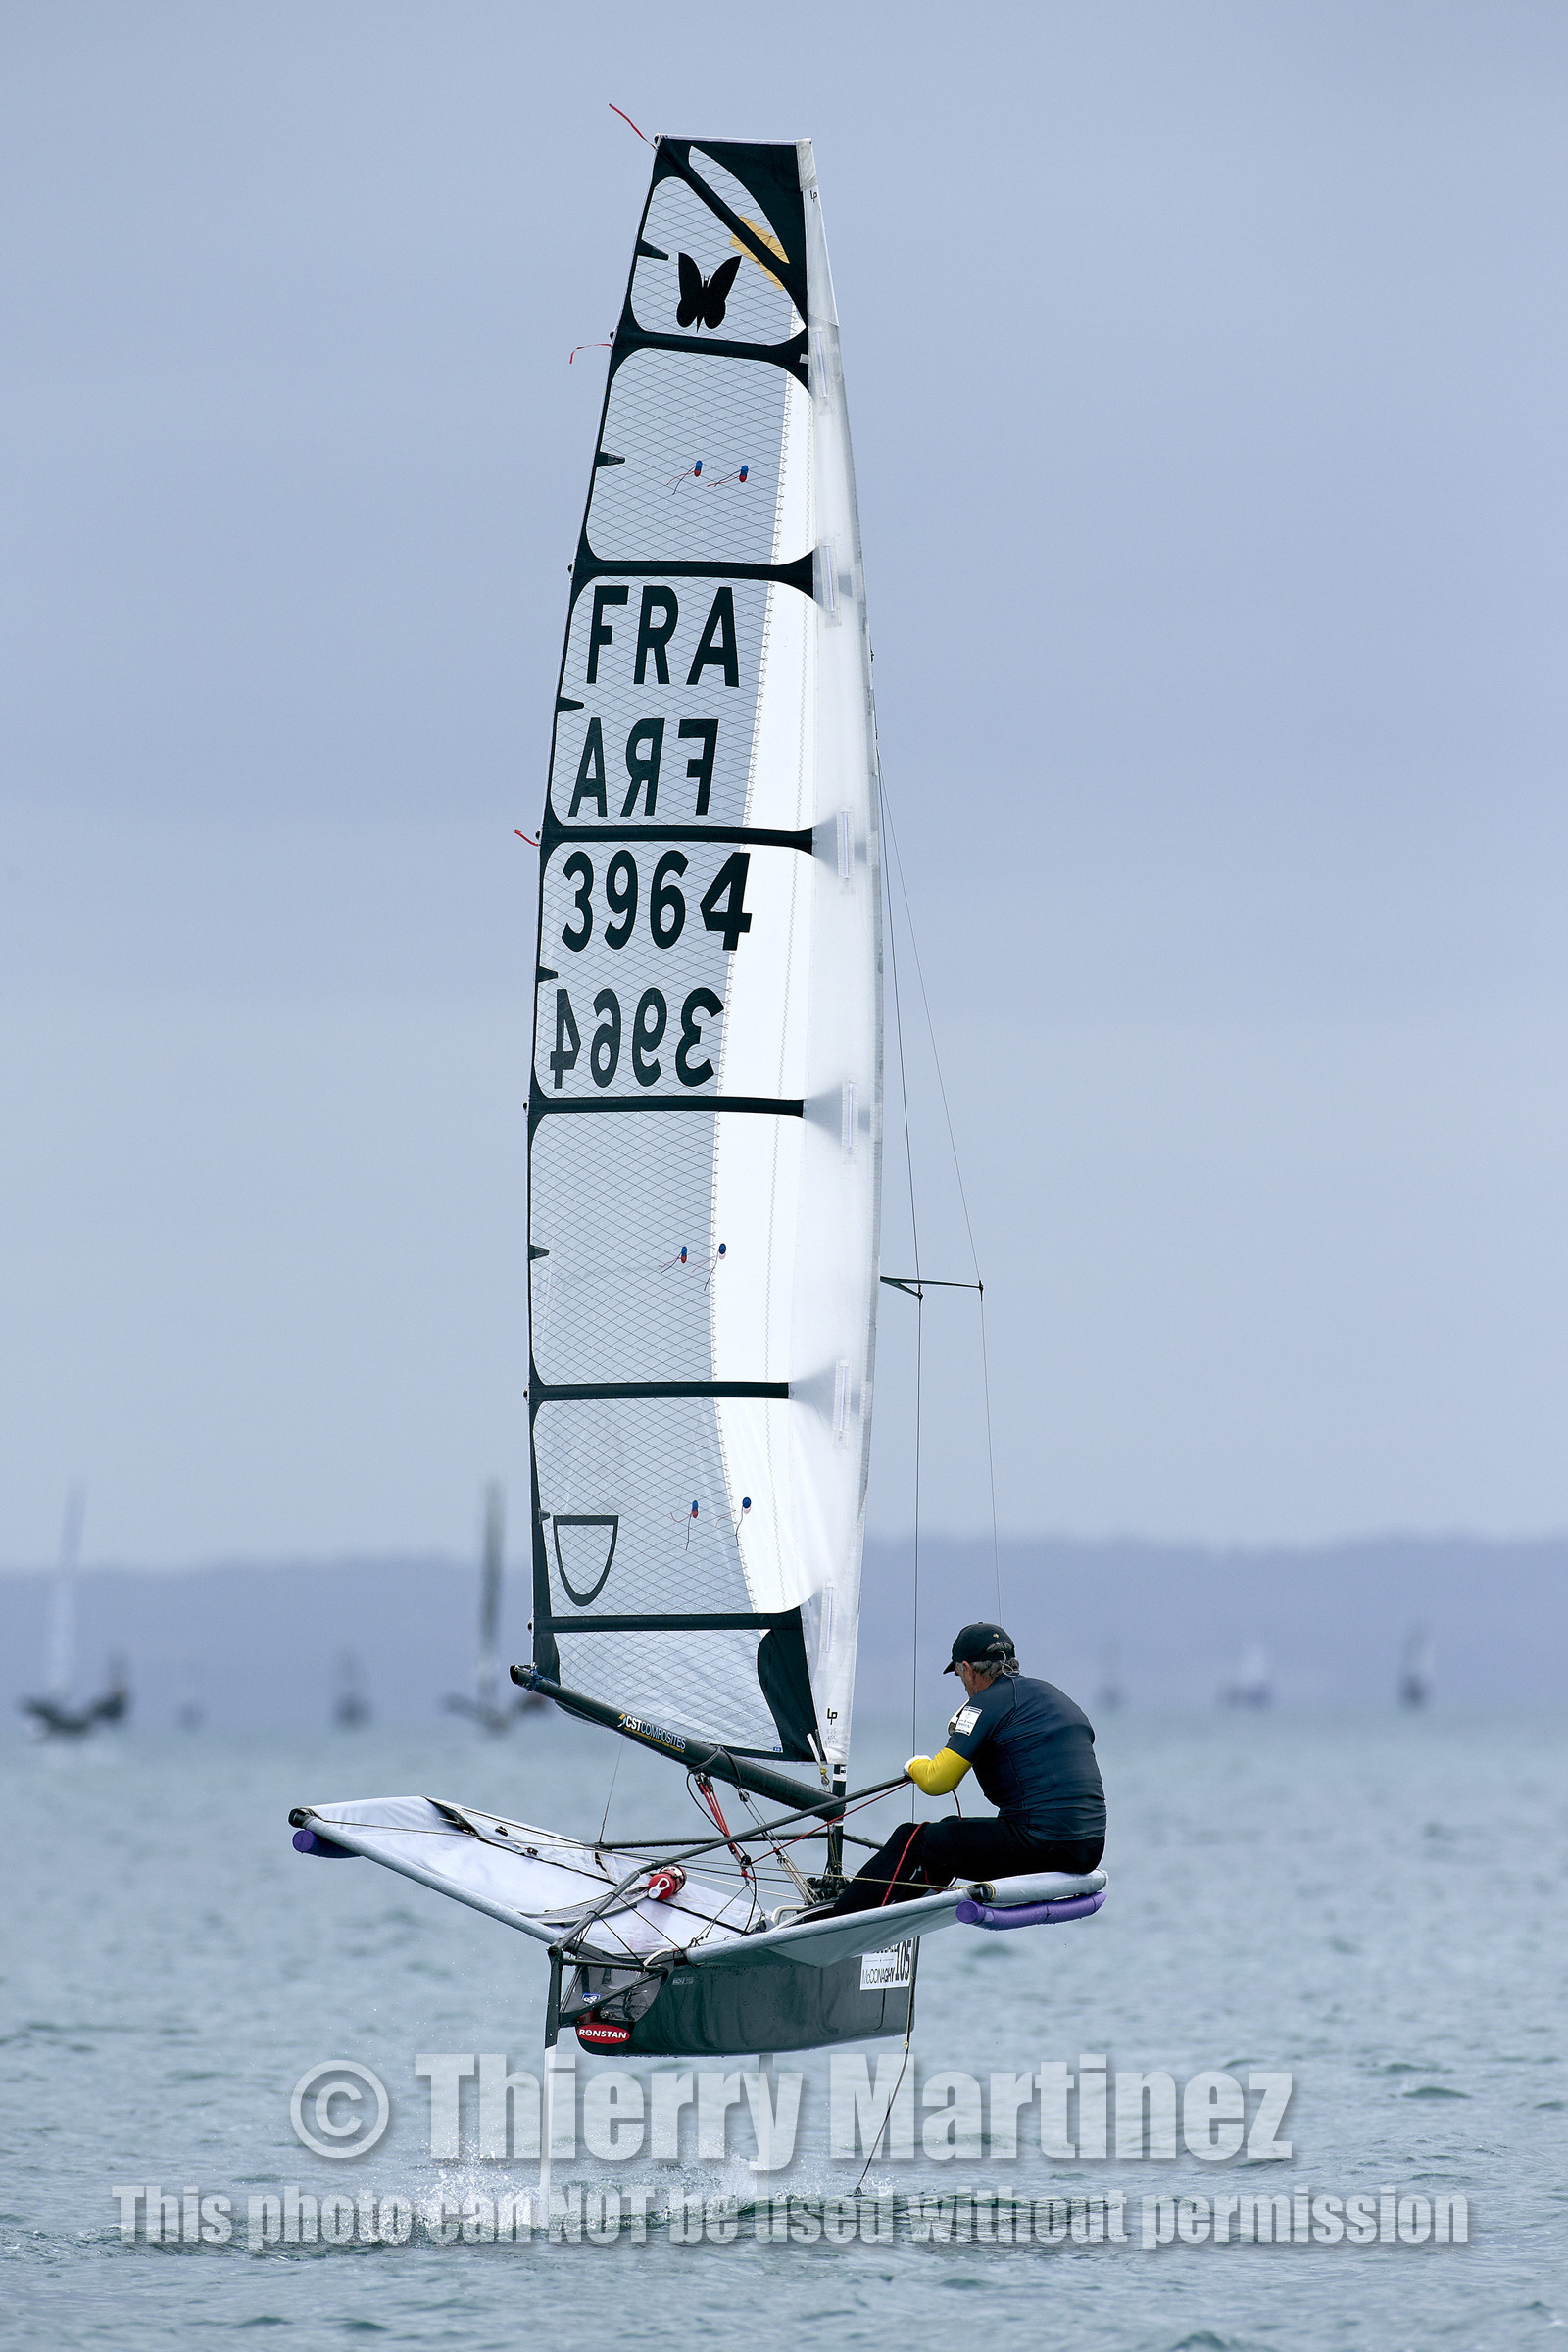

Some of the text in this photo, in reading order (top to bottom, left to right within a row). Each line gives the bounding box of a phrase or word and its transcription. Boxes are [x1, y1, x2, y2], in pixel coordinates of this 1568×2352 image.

[586, 585, 740, 687] FRA
[561, 850, 753, 952] 3964
[578, 2029, 627, 2039] RONSTAN
